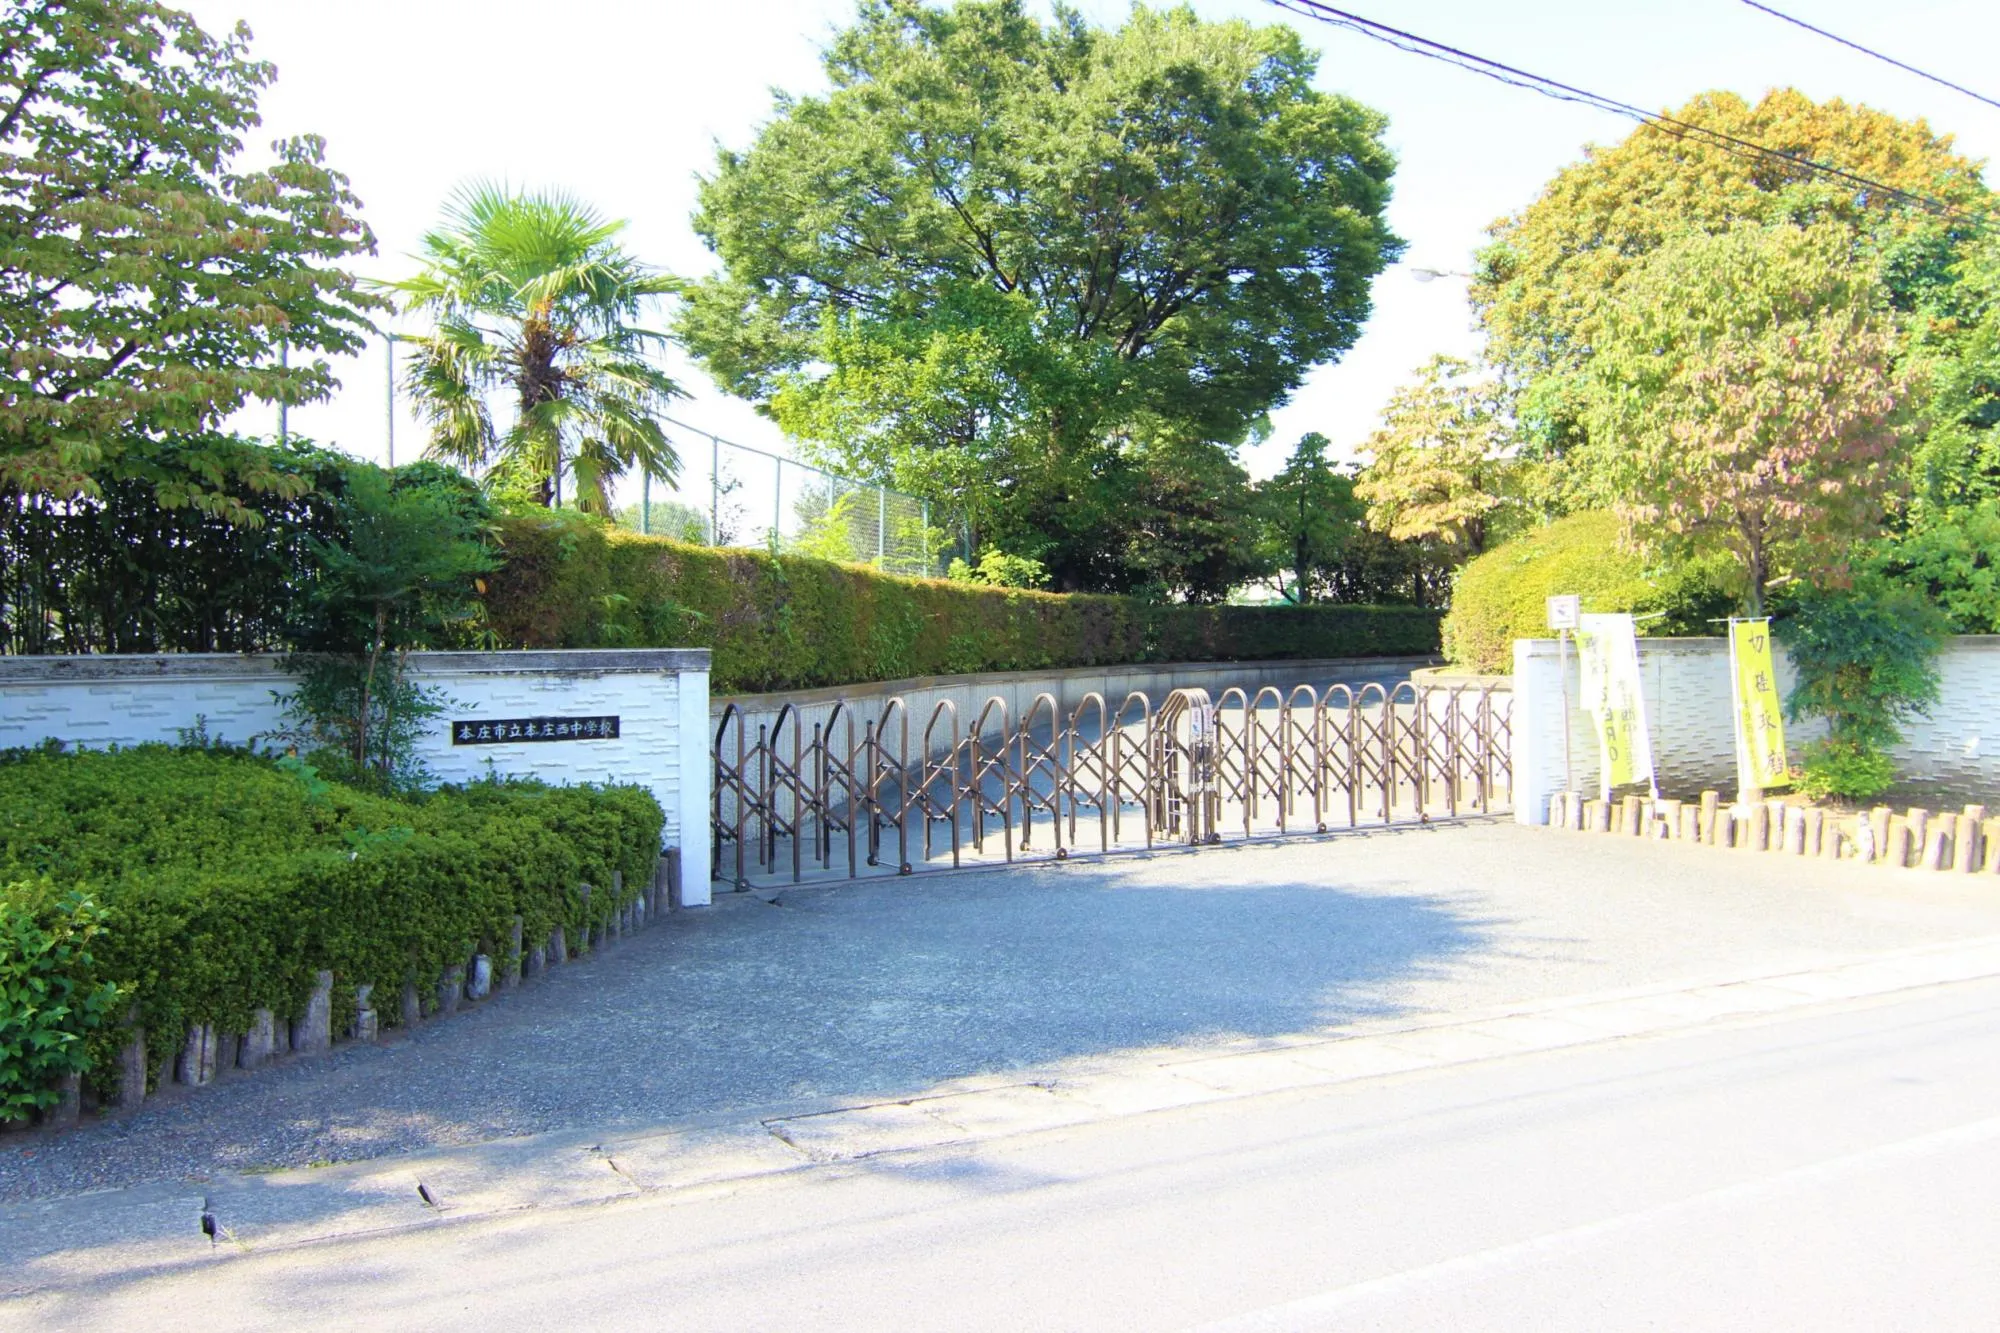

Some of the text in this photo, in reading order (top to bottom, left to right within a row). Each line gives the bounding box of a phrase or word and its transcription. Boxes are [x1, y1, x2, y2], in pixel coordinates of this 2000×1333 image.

[458, 717, 615, 741] 本庄市立本庄西中学校
